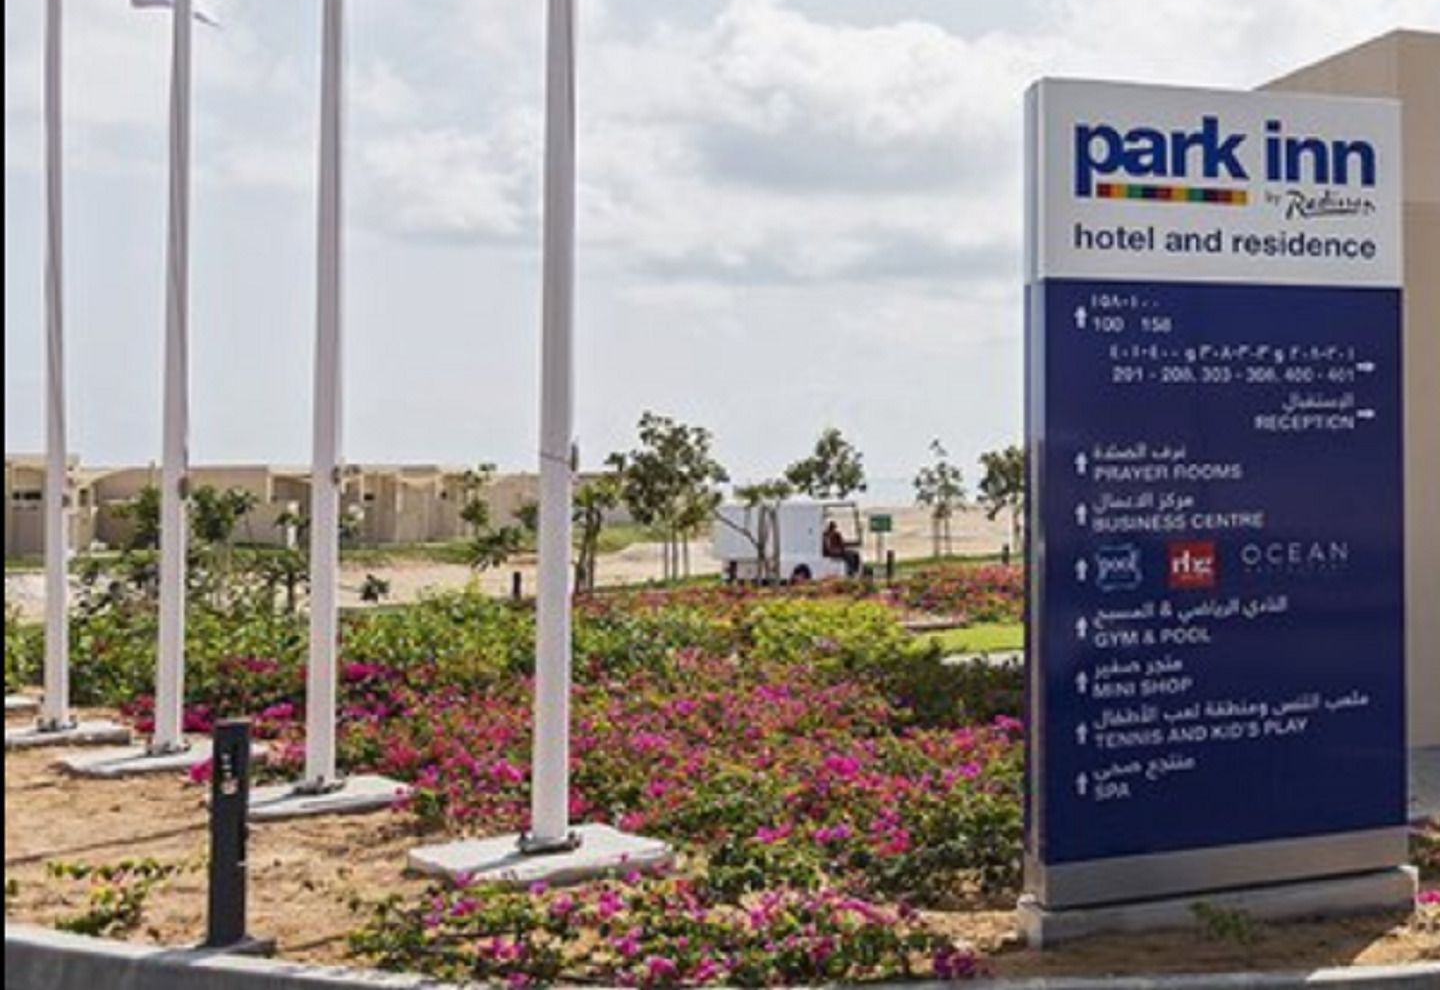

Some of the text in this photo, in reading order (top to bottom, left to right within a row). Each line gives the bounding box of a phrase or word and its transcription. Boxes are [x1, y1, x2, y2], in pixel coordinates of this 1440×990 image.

[1074, 116, 1376, 198] park inn
[1074, 223, 1377, 259] hotel and residence
[1093, 316, 1125, 333] 100
[1253, 413, 1355, 430] RECEPTION
[1093, 462, 1243, 481] PRAYER ROOMS
[1092, 512, 1266, 532] BUSINESS CENTRE
[1240, 541, 1350, 566] OCEAN
[1093, 626, 1212, 649] GYM & POOL
[1092, 677, 1194, 699] MINI SHOP
[1093, 717, 1309, 749] TENNIS AND KID'S PLAY
[1093, 781, 1131, 801] SPA
